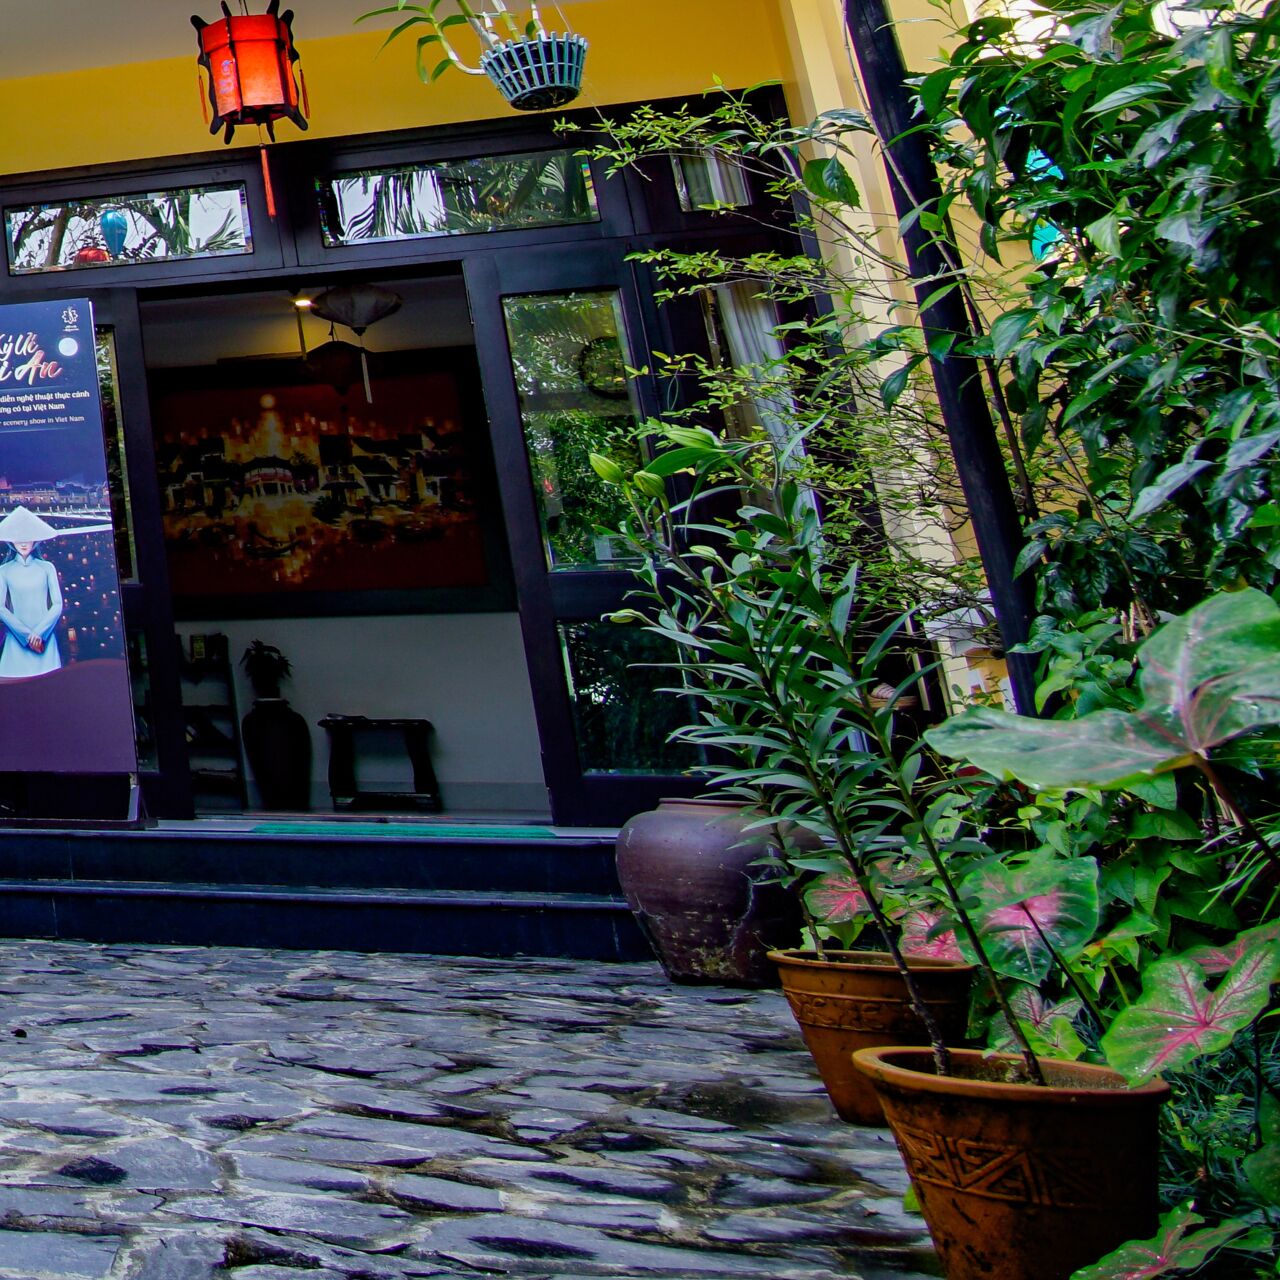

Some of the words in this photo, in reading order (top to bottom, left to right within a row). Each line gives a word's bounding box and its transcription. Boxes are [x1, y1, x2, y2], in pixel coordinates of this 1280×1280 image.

[13, 349, 63, 386] An
[16, 394, 34, 403] nghệ
[12, 405, 22, 413] có
[32, 403, 47, 412] Việt
[48, 402, 66, 410] Nam
[2, 419, 29, 427] scenery
[29, 417, 47, 425] show
